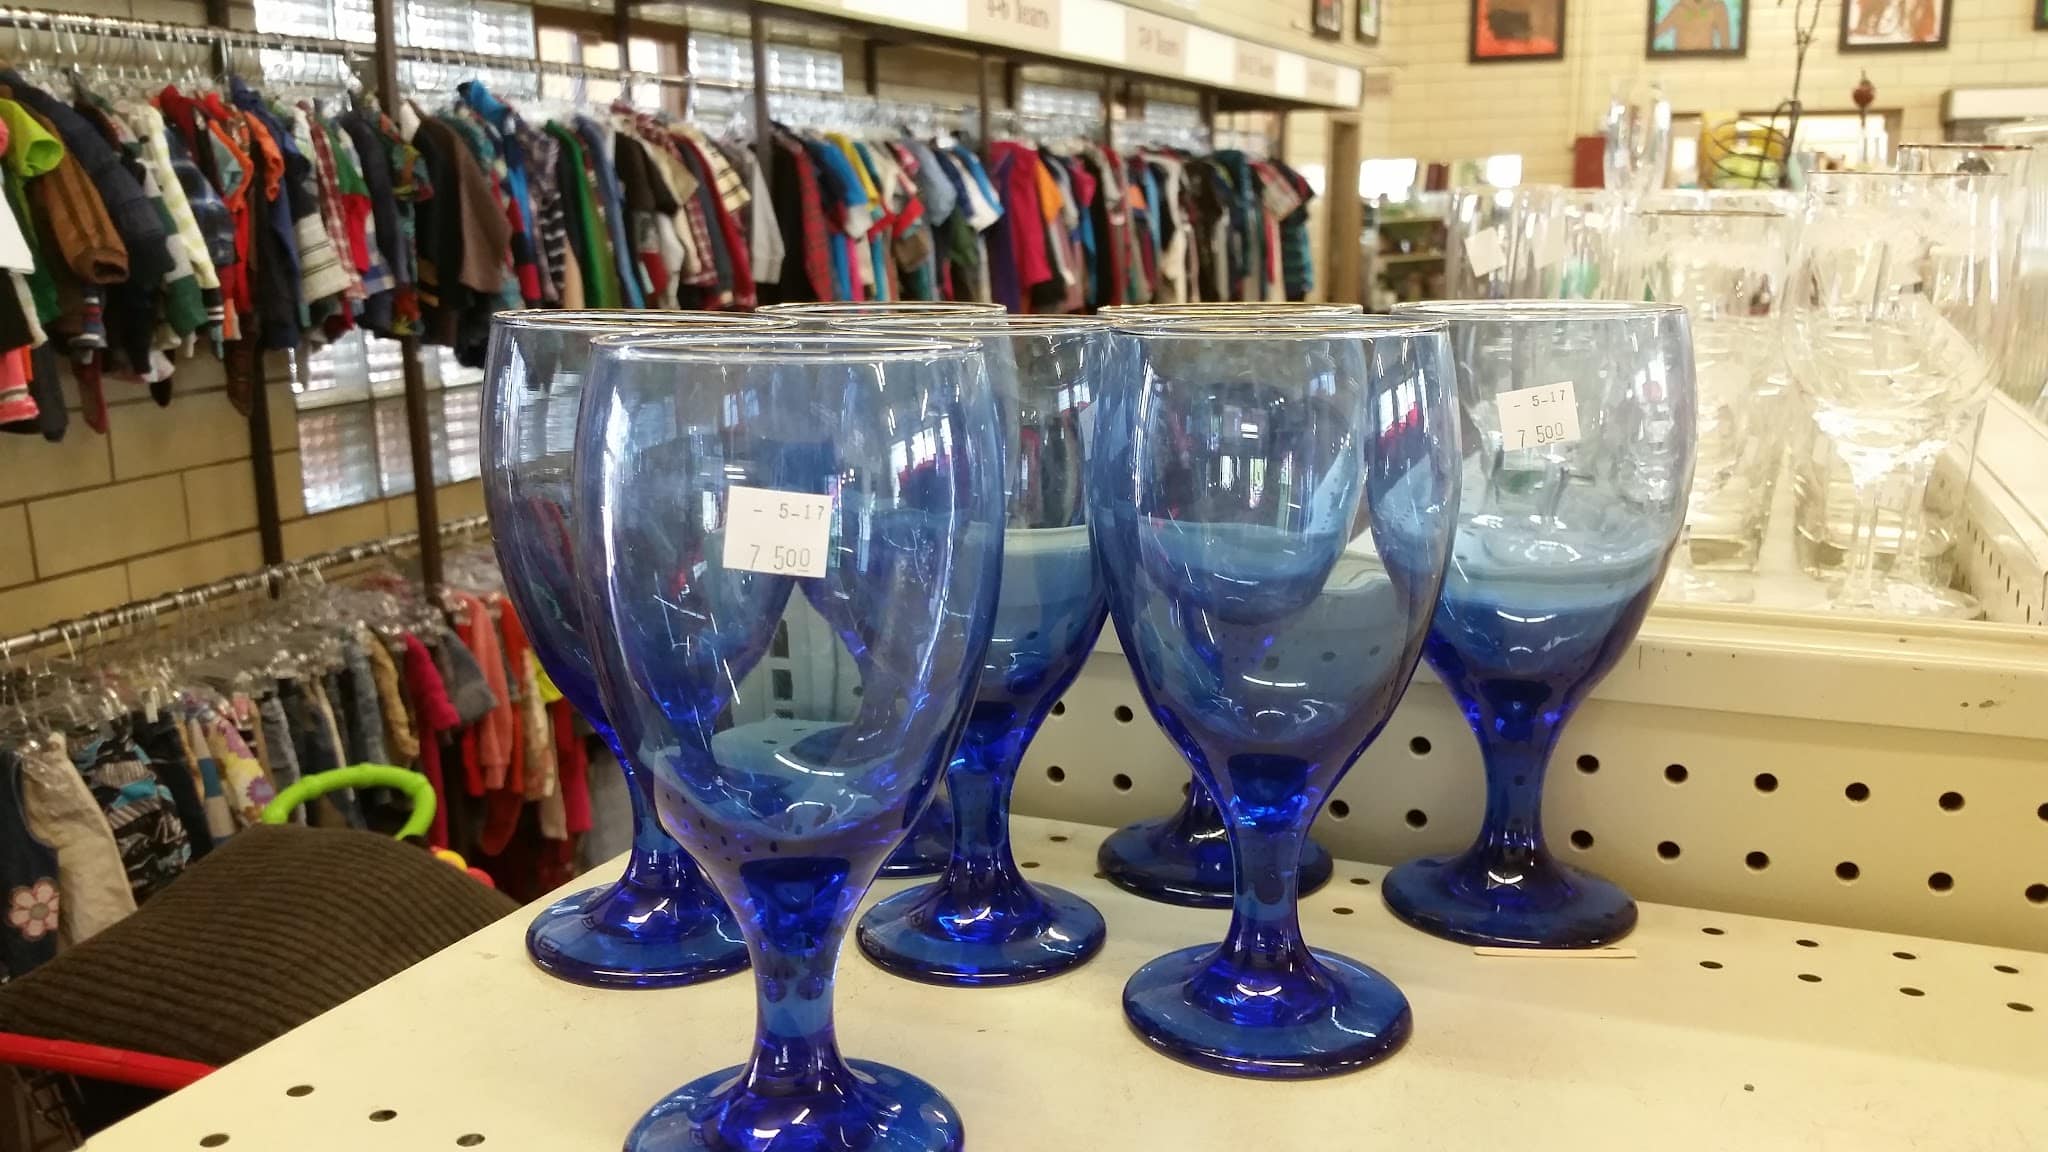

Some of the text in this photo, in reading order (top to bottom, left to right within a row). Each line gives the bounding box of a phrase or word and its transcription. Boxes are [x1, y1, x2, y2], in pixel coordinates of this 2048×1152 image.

[1531, 389, 1565, 407] 5-17
[1517, 429, 1526, 449] 7
[779, 503, 825, 520] 5-17
[750, 544, 761, 570] 7
